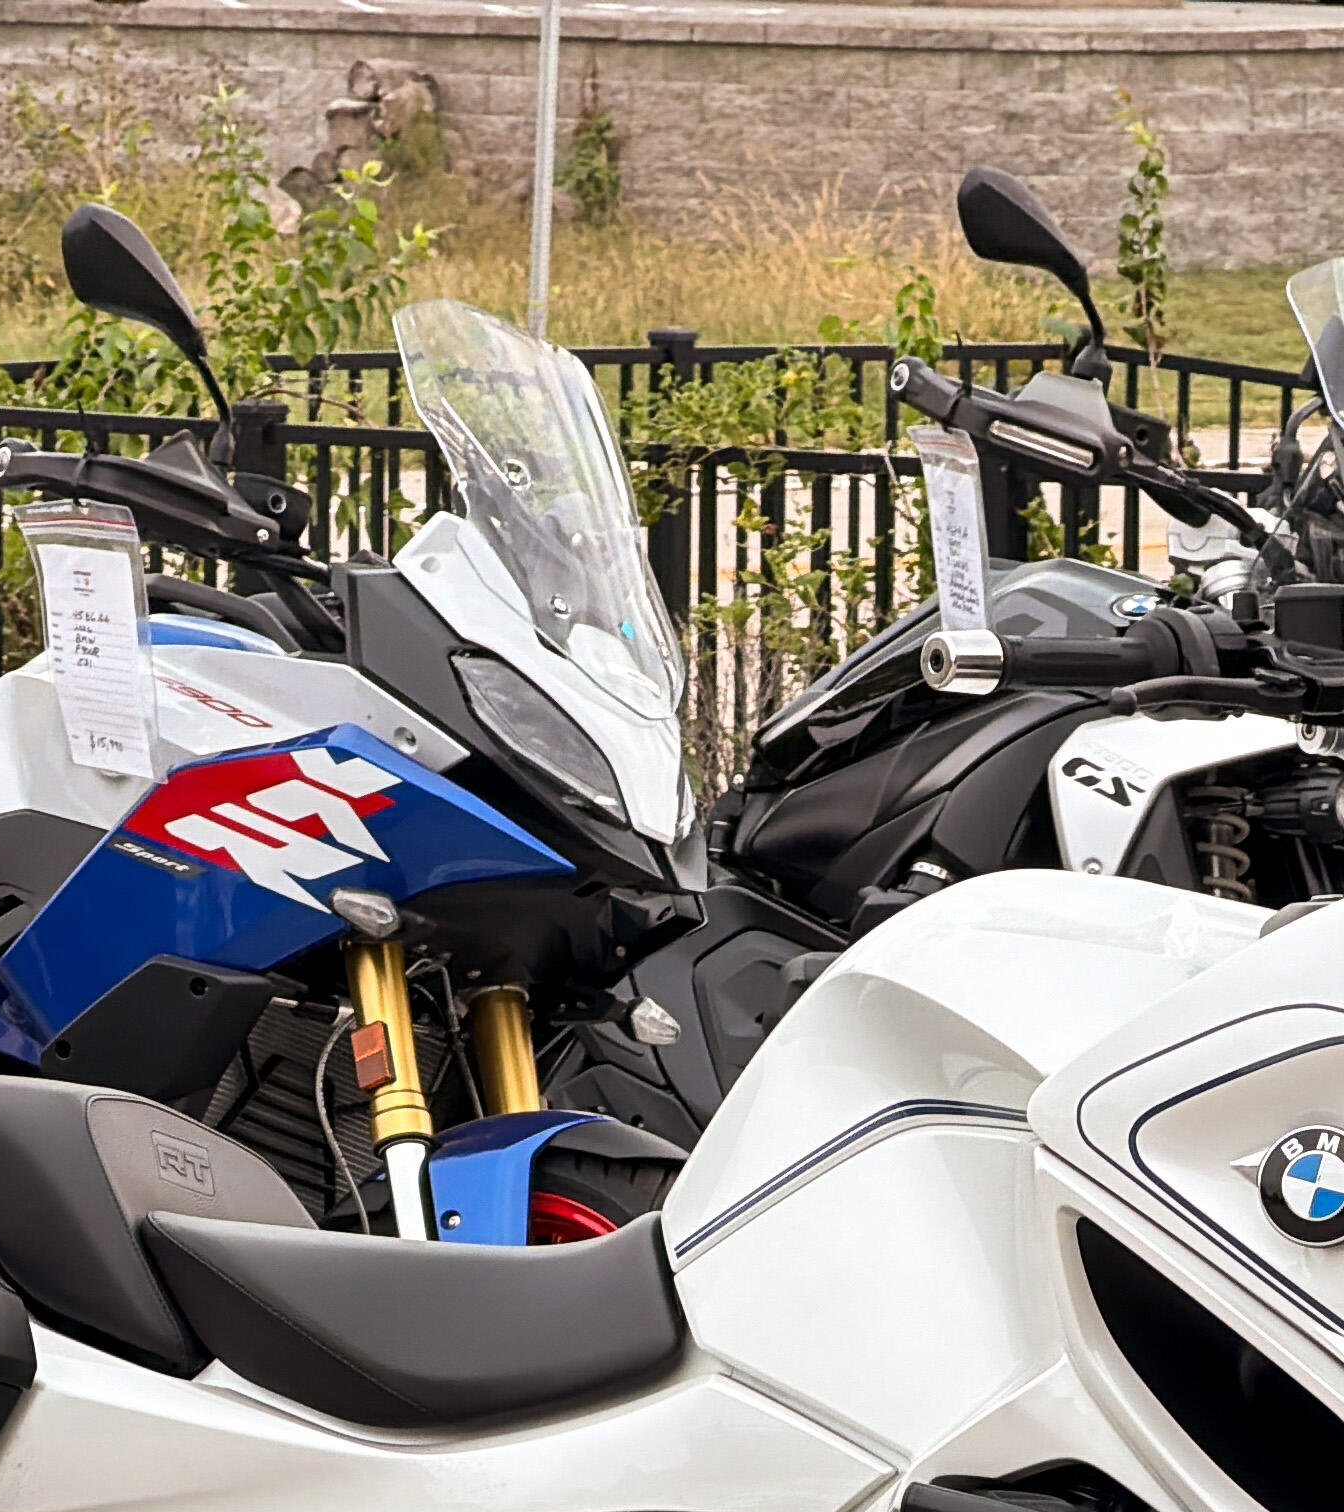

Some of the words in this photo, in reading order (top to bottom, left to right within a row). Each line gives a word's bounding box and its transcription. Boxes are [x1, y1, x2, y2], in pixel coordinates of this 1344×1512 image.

[1061, 757, 1146, 807] GS
[113, 842, 191, 872] Sport
[156, 1143, 210, 1183] RT
